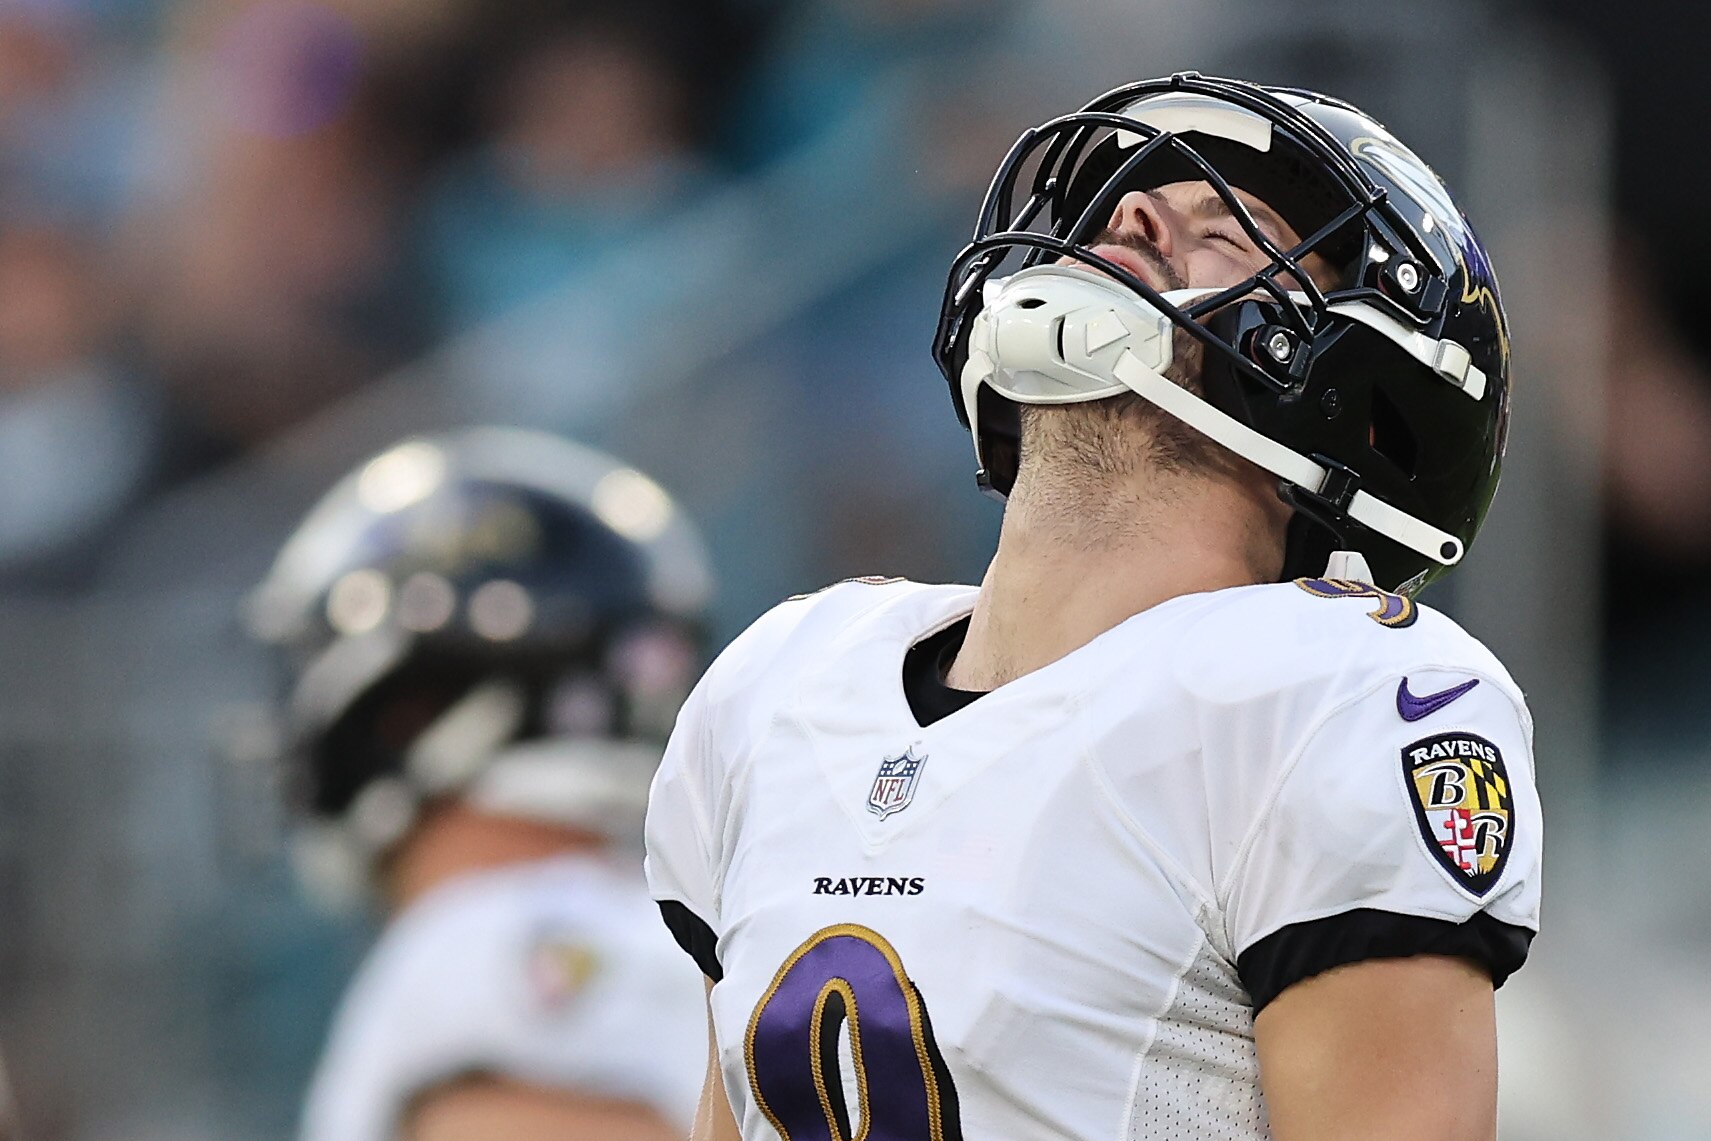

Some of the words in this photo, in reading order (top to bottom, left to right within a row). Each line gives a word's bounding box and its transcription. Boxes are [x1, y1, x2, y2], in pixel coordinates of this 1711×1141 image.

[1409, 740, 1497, 765] RAVENS
[872, 778, 906, 805] NFL
[1415, 762, 1468, 808] B
[813, 877, 925, 897] RAVENS
